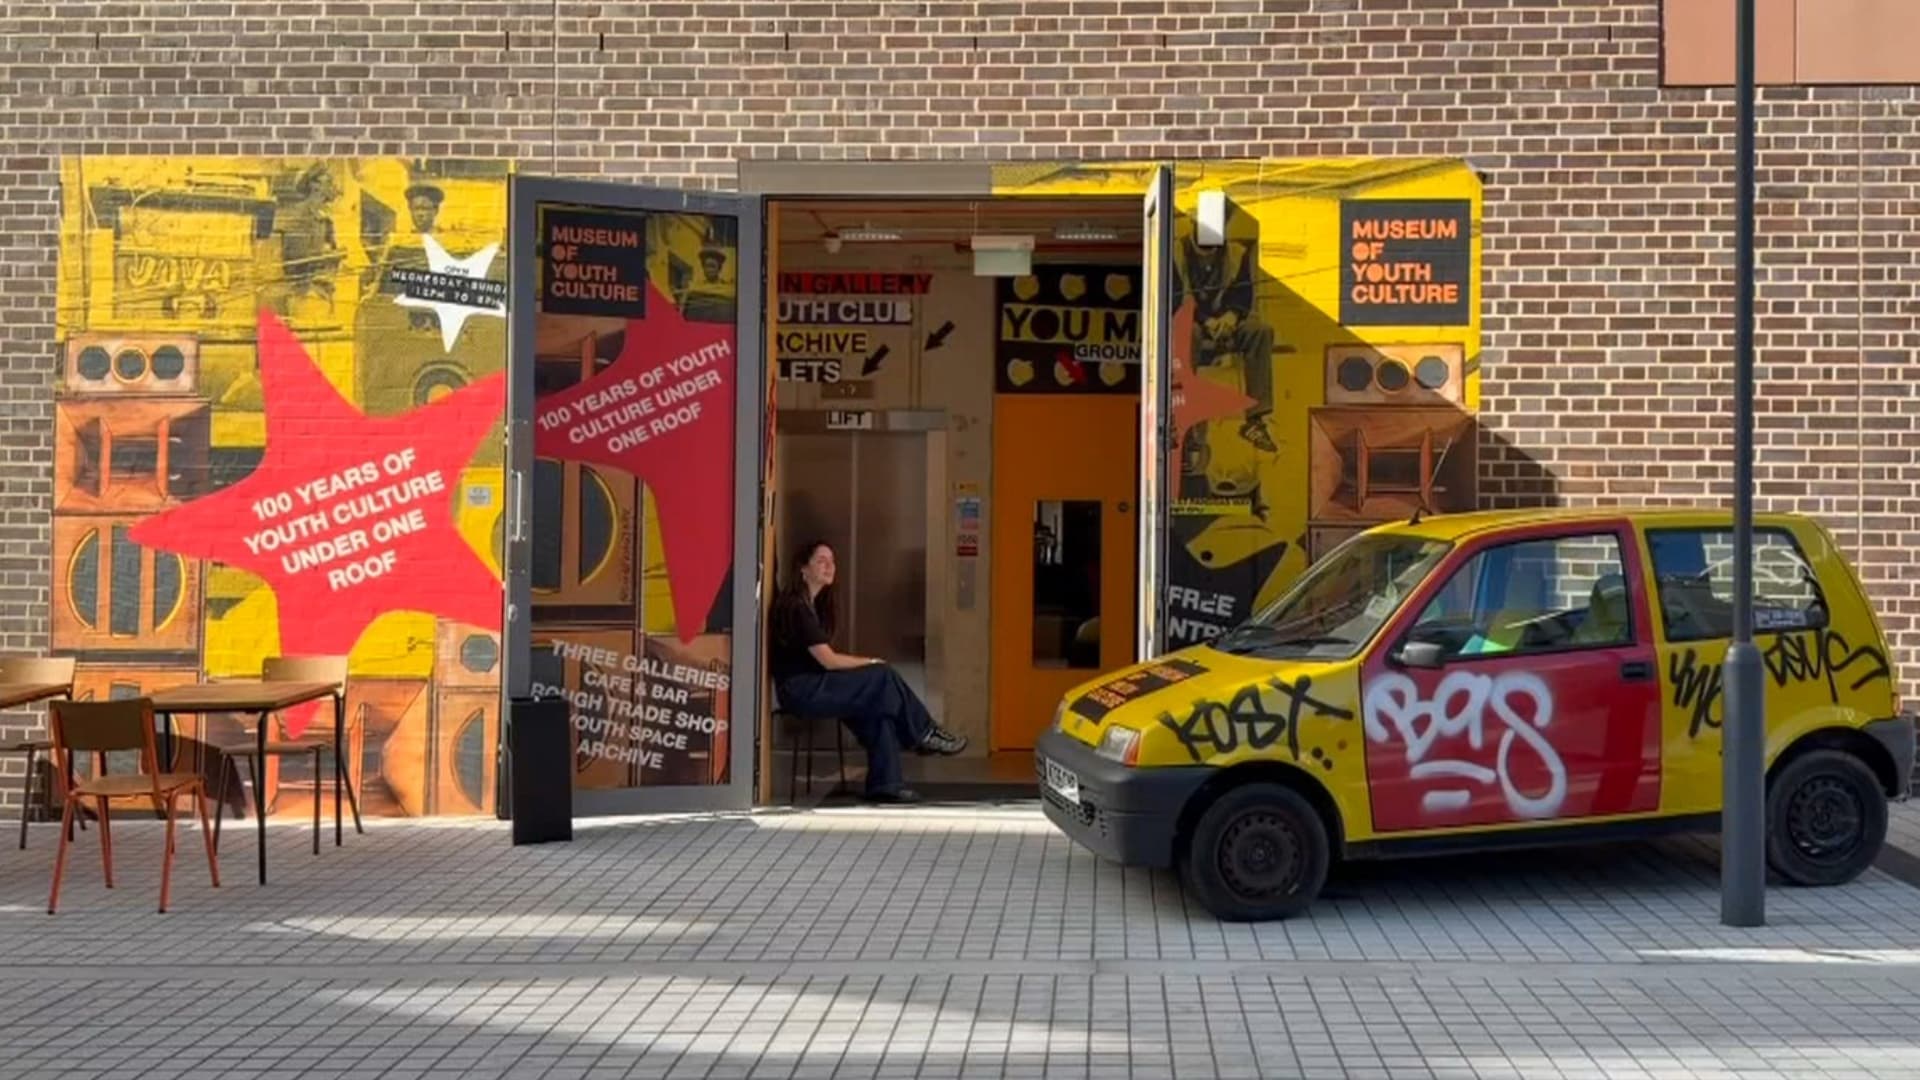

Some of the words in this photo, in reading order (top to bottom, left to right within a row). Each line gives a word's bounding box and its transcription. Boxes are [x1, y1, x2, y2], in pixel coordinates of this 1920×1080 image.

[552, 225, 638, 248] MUSEUM
[1352, 219, 1457, 239] MUSEUM
[552, 244, 578, 260] OF
[1352, 242, 1384, 261] OF
[552, 262, 617, 282] YOUTH
[778, 273, 799, 294] IN
[813, 273, 933, 294] GALLERY
[1351, 263, 1431, 282] YOUTH
[551, 281, 640, 302] CULTURE
[1351, 284, 1458, 304] CULTURE
[778, 301, 829, 322] UTH
[838, 301, 911, 322] CLUB
[1004, 308, 1090, 341] YOU
[1104, 311, 1141, 342] M
[1076, 344, 1140, 360] GROUN
[778, 361, 841, 383] LETS
[537, 406, 571, 431] 100
[571, 379, 638, 416] YEARS
[639, 367, 666, 389] OF
[666, 340, 731, 376] YOUTH
[569, 397, 655, 444] CULTURE
[656, 370, 722, 407] UNDER
[828, 411, 866, 425] LIFT
[607, 427, 650, 453] ONE
[650, 402, 702, 436] ROOF
[252, 492, 292, 520] 100
[295, 462, 380, 504] YEARS
[383, 448, 416, 475] OF
[243, 511, 329, 554] YOUTH
[333, 470, 445, 524] CULTURE
[281, 530, 369, 574] UNDER
[372, 509, 427, 543] ONE
[328, 550, 397, 591] ROOF
[1169, 615, 1227, 642] NTR
[552, 639, 618, 668] THREE
[623, 656, 731, 690] GALLERIES
[583, 671, 633, 693] CAFE
[634, 683, 648, 697] &
[652, 685, 688, 704] BAR
[607, 698, 672, 725] TRADE
[675, 711, 728, 735] SHOP
[629, 726, 688, 750] SPACE
[577, 739, 664, 769] ARCHIVE
